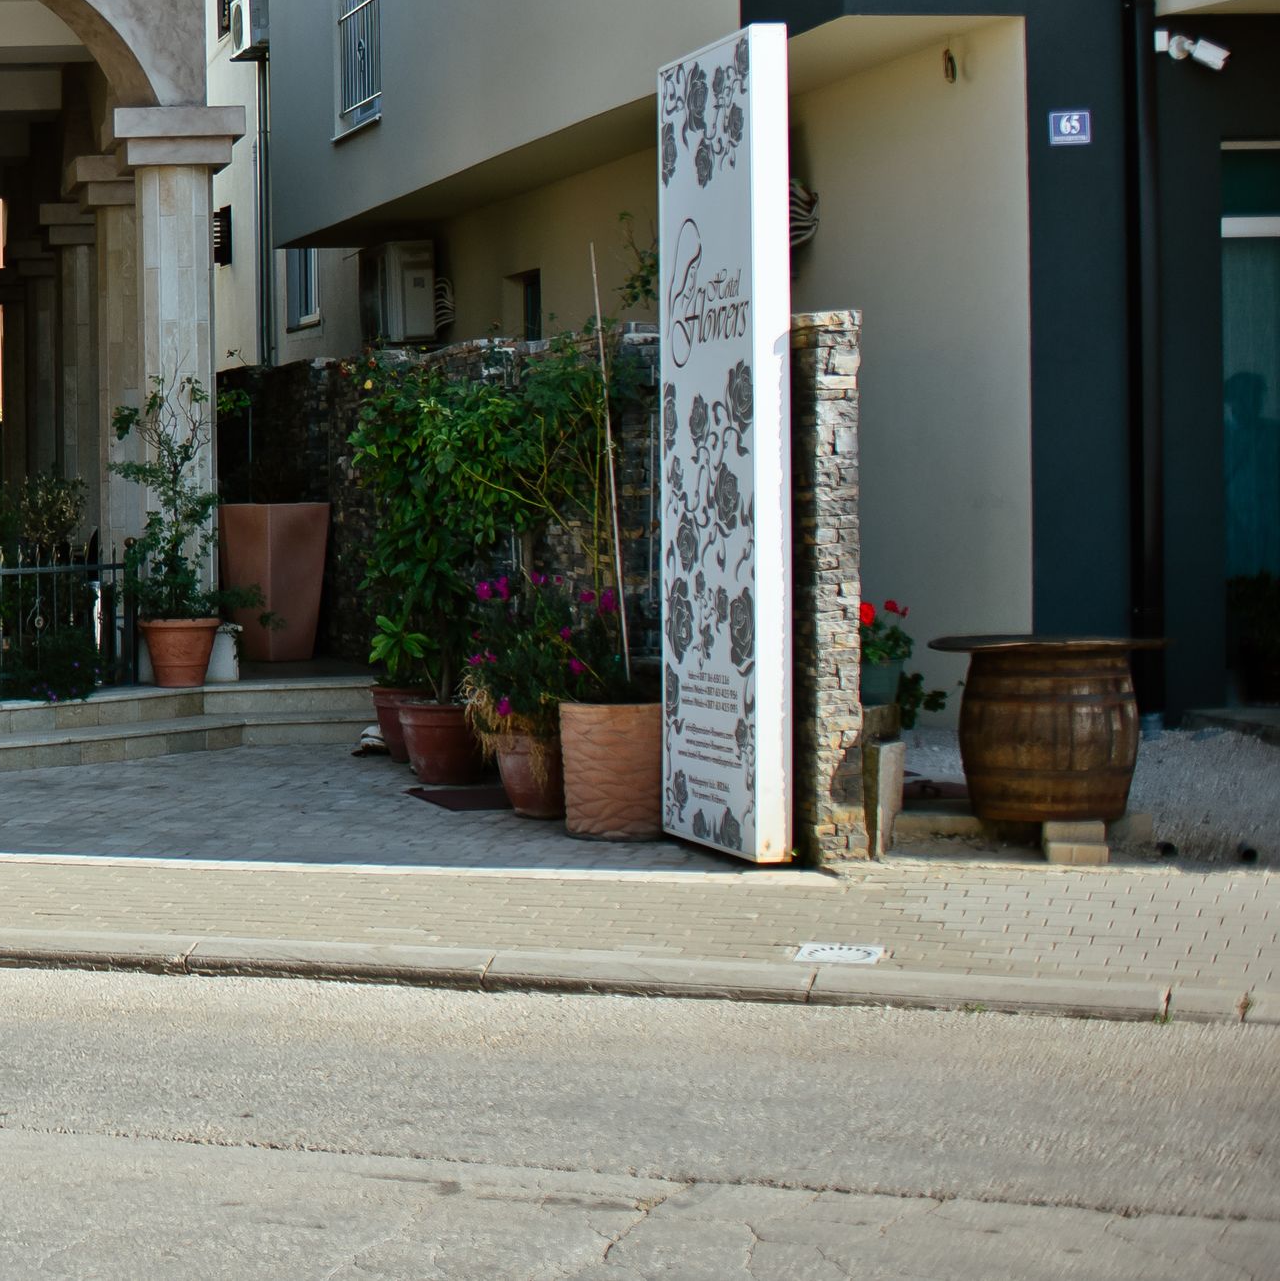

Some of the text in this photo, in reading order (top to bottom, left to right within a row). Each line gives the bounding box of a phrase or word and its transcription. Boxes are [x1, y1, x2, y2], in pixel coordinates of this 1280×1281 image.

[1060, 115, 1081, 134] 65
[707, 268, 742, 302] Hotel
[672, 287, 750, 368] Flowers
